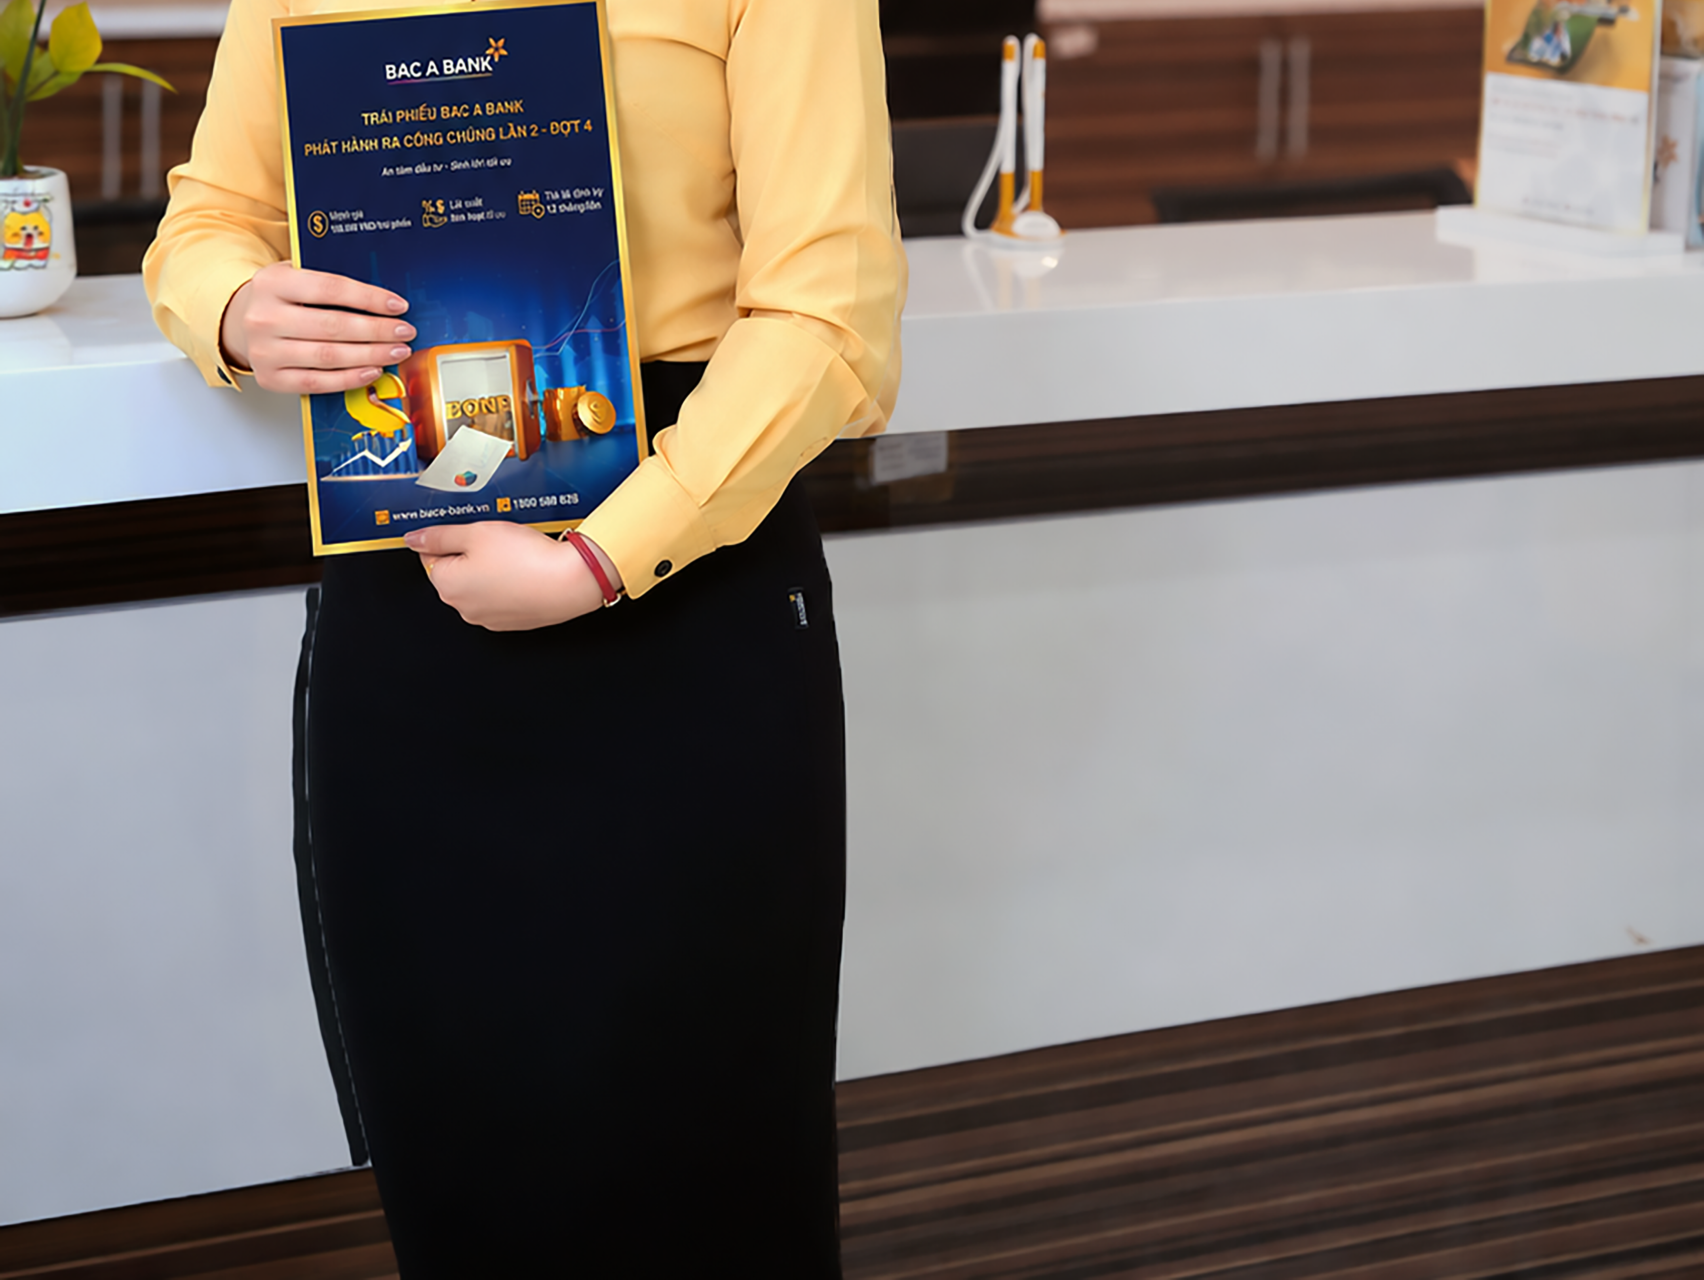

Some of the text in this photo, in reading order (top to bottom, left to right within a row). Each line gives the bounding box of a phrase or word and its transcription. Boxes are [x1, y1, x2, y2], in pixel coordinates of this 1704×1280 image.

[385, 56, 493, 80] BAC A BANK
[441, 104, 469, 119] BAC
[473, 103, 483, 116] A
[486, 99, 525, 116] BANK
[382, 136, 401, 149] RA
[529, 124, 539, 137] 2
[584, 119, 593, 132] 4
